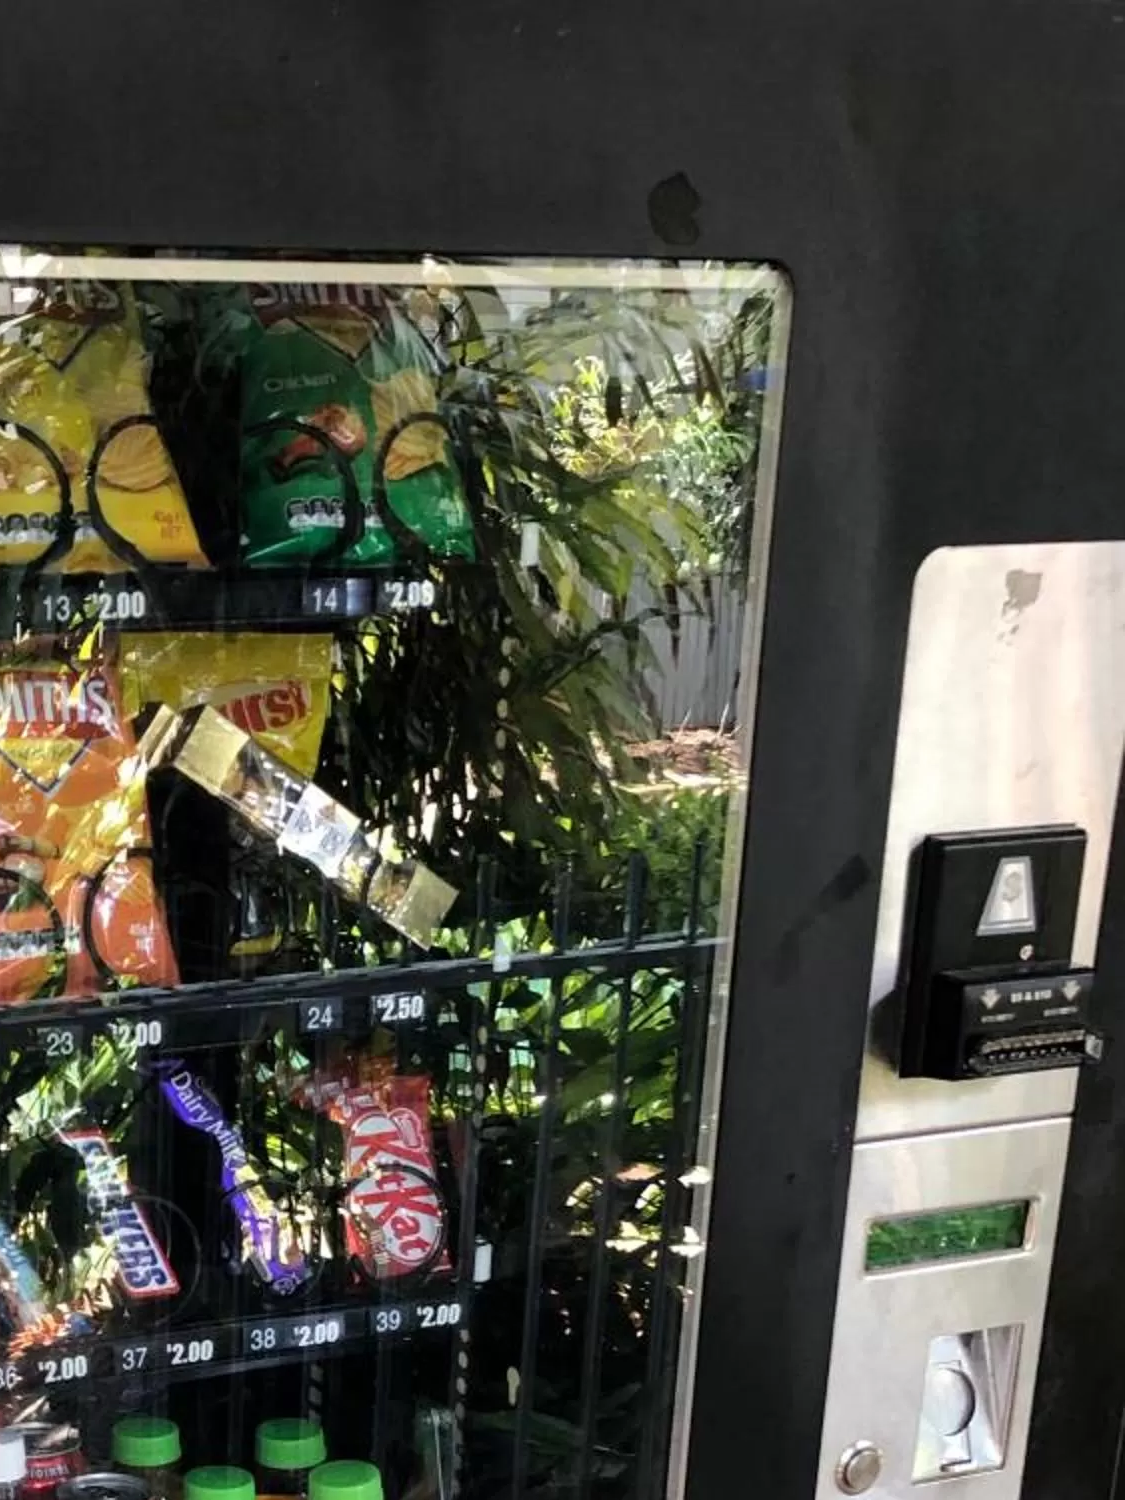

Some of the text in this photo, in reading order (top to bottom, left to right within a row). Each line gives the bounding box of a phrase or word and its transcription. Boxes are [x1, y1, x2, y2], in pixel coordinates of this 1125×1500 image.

[42, 596, 71, 620] 13
[312, 588, 338, 611] 14
[307, 1005, 333, 1029] 24
[46, 1032, 74, 1057] 23
[170, 1071, 248, 1171] Dairy Milk
[376, 1310, 401, 1333] 39
[251, 1328, 276, 1351] 38
[123, 1348, 148, 1371] 37
